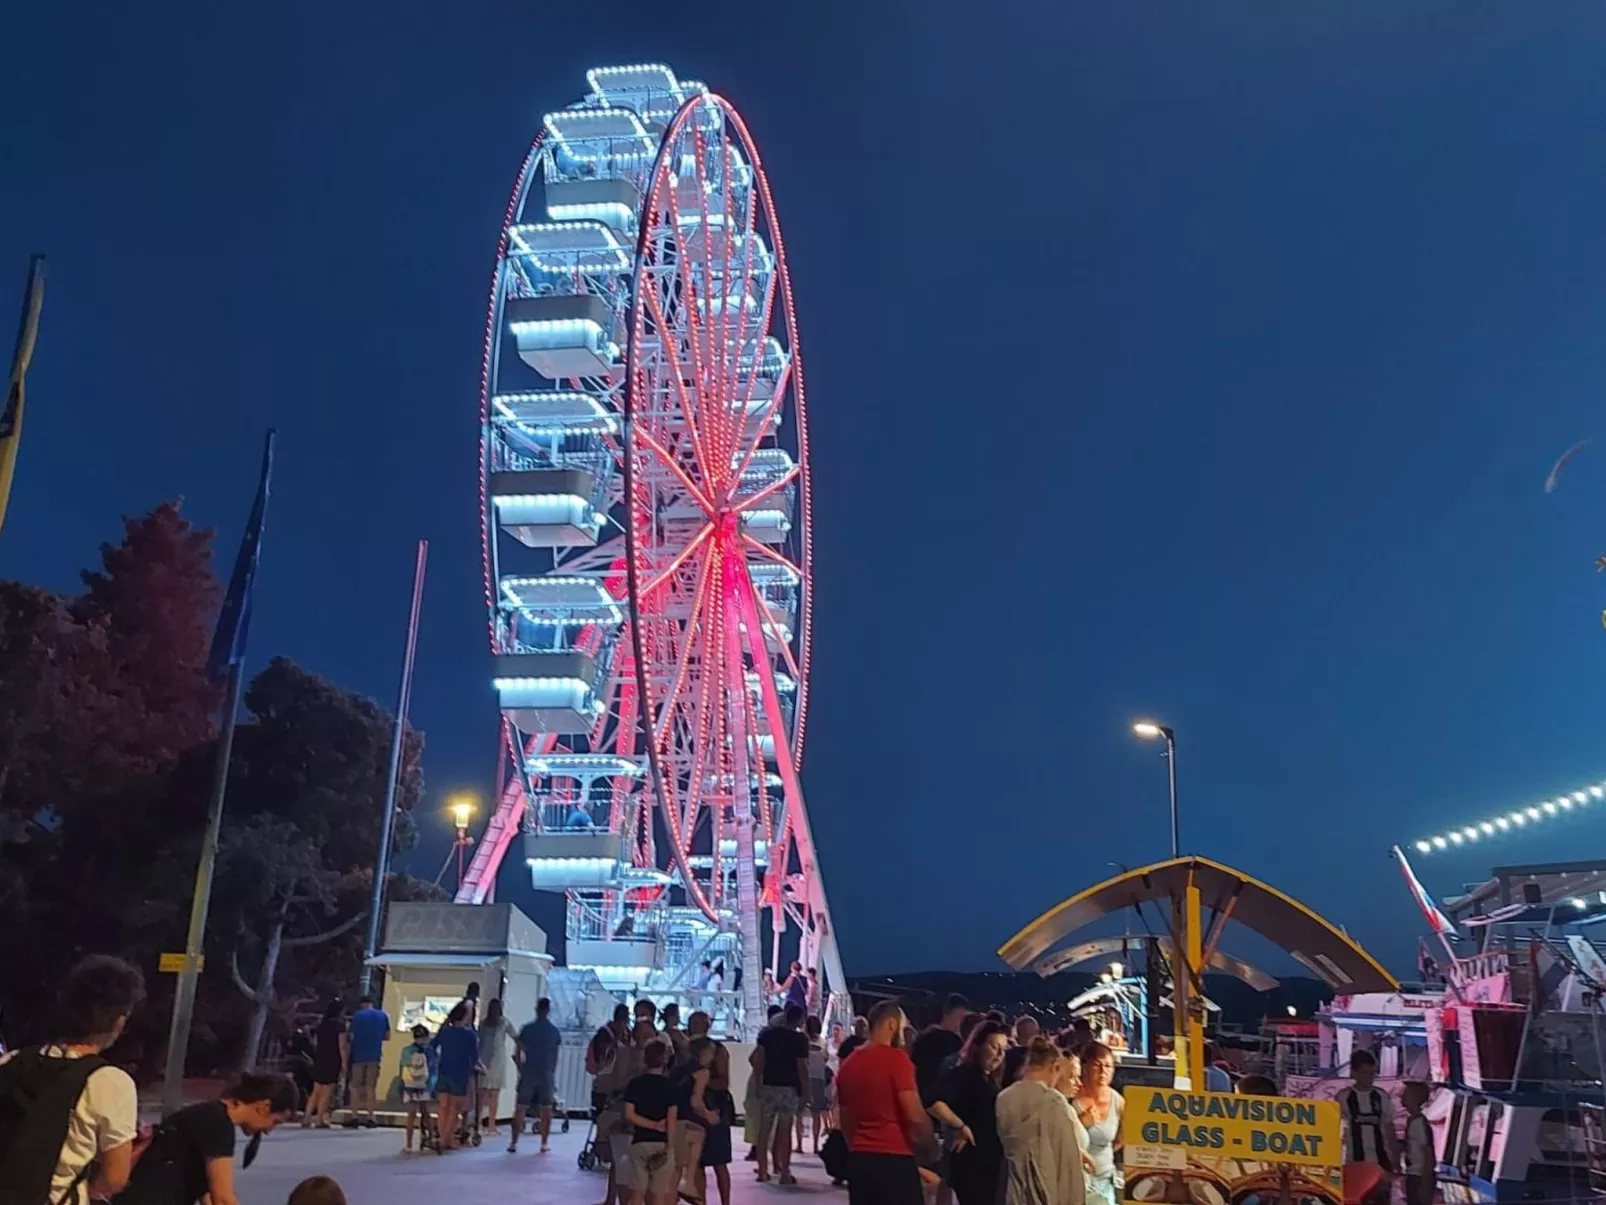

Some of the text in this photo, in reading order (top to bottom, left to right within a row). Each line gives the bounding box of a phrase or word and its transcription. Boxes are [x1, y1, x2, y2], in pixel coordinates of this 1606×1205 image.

[1148, 1092, 1316, 1126] AQUAVISION
[1141, 1121, 1224, 1148] GLASS
[1251, 1130, 1323, 1157] BOAT
